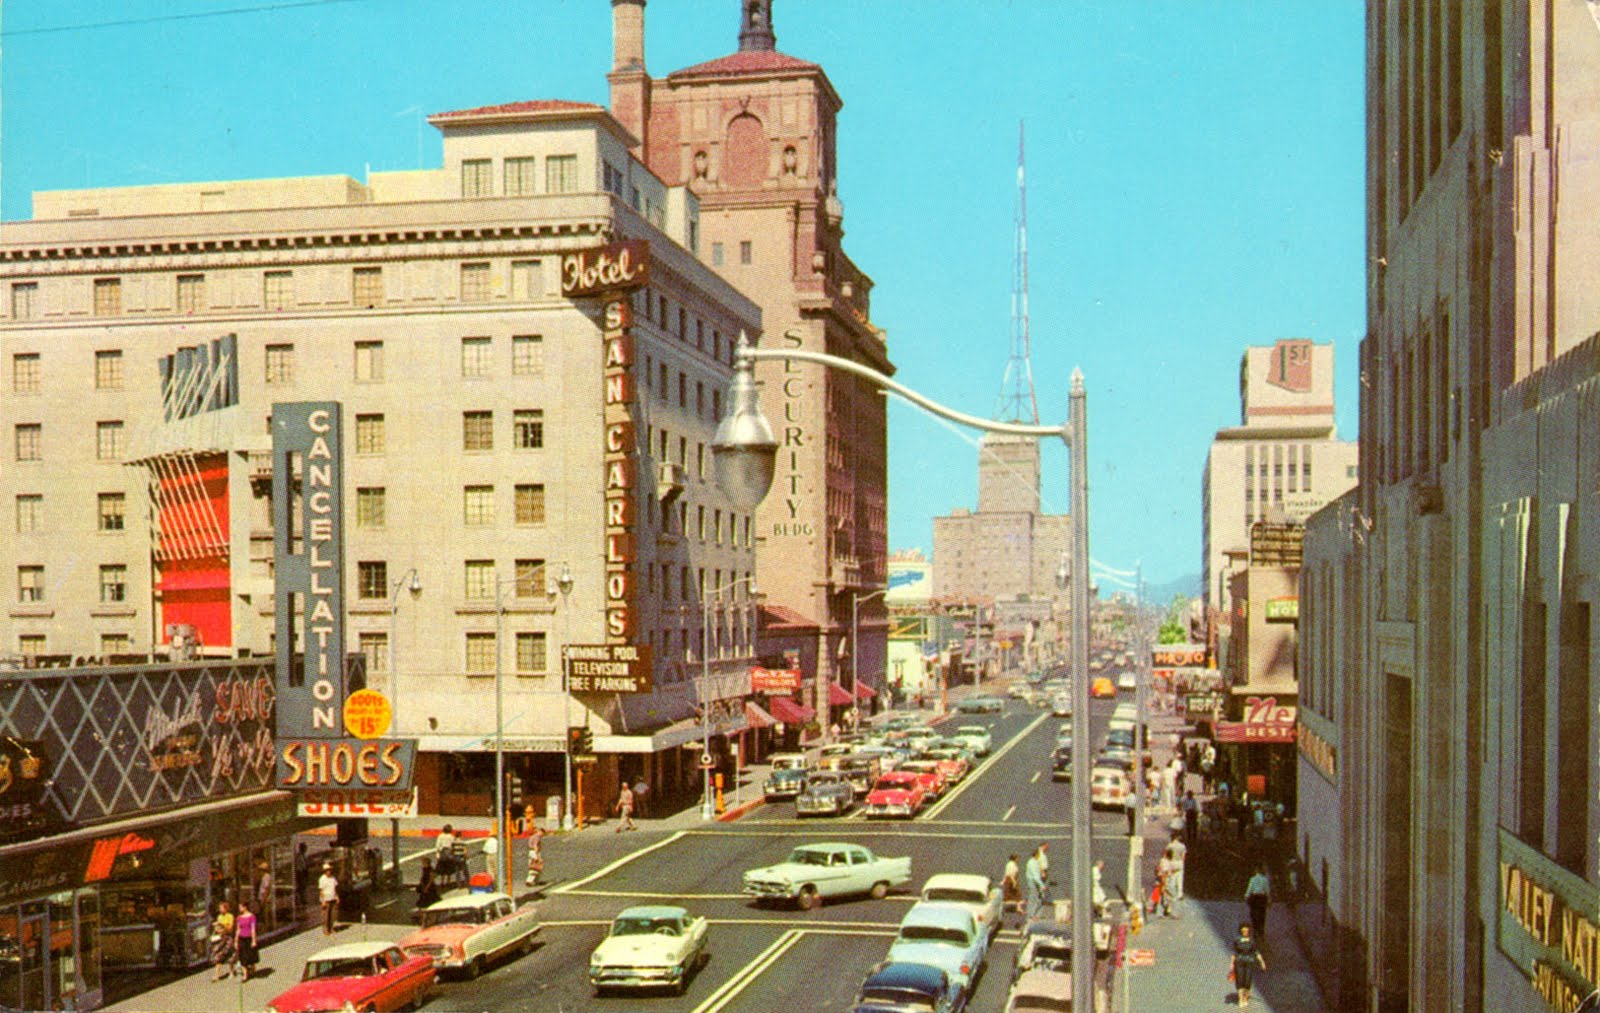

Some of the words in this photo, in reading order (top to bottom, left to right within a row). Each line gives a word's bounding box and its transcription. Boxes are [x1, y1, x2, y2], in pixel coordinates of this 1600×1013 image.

[562, 248, 637, 289] Hotel
[605, 302, 626, 404] SAN
[783, 328, 803, 519] SECURITY
[606, 423, 628, 636] CARLOS
[773, 523, 813, 537] BLDG
[307, 409, 335, 730] CANCELLATION
[573, 662, 629, 676] TELEVISION
[613, 646, 640, 662] POOL
[215, 678, 276, 723] SAVE
[594, 676, 638, 692] PARKING
[282, 741, 405, 787] SHOES
[304, 790, 385, 814] SALE
